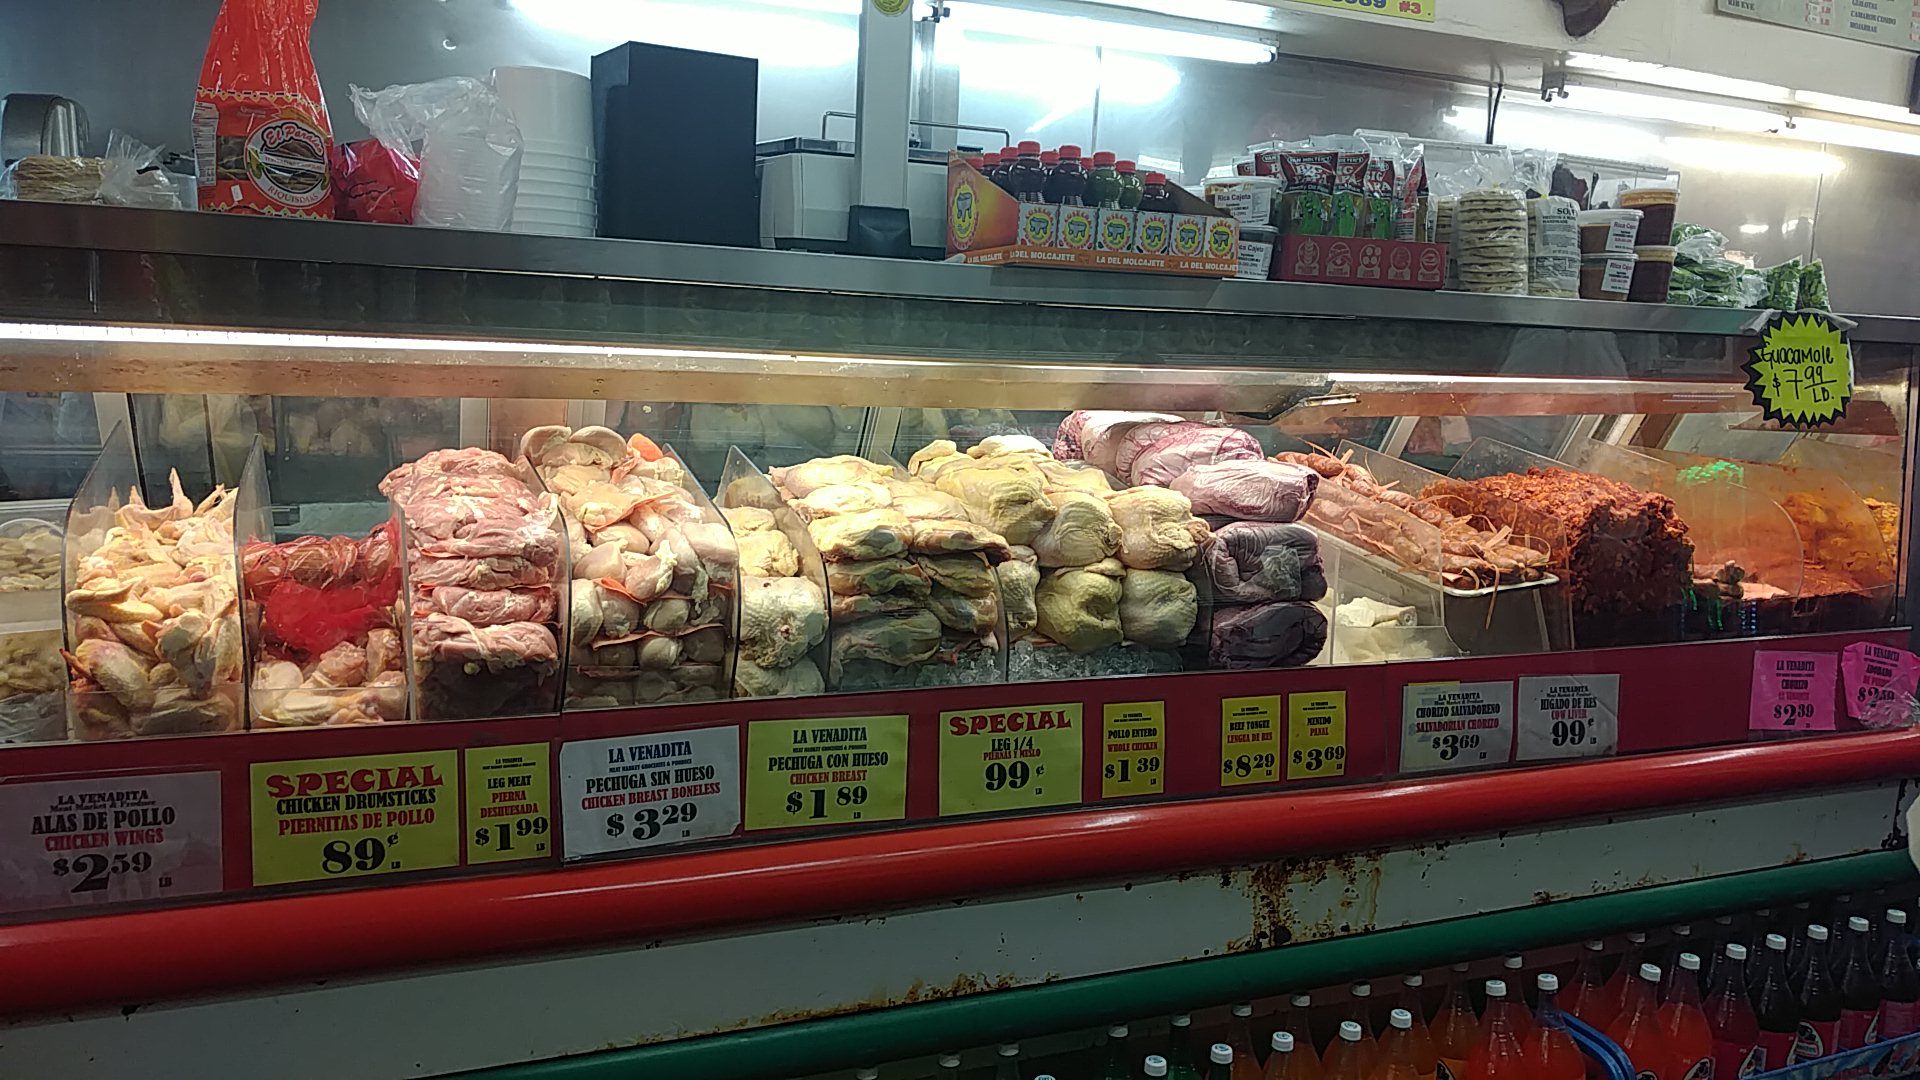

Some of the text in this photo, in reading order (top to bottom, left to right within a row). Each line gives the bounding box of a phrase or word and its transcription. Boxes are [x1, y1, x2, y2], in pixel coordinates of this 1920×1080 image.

[1030, 251, 1075, 262] MOLCAJETE
[1096, 255, 1165, 268] LA DEL MOLCAJETE
[1180, 260, 1189, 269] LA
[1191, 261, 1203, 270] DEL
[1438, 692, 1480, 701] LA VENADITA
[1559, 685, 1589, 693] VENADITA
[1416, 703, 1501, 719] CHORIZO SALVADORENO
[1540, 697, 1597, 710] HIGADO DE RES
[949, 709, 1072, 736] SPECIAL
[1230, 721, 1246, 732] BEEF
[1467, 718, 1500, 730] CHORIZO
[793, 727, 867, 744] LA VENADITA
[1108, 727, 1157, 740] POLLO ENTERO
[991, 735, 1033, 752] LEG 1/4
[1107, 741, 1158, 753] WHOLE CHICKEN
[608, 740, 692, 764] LA VENADITA
[983, 749, 1012, 762] PIERNAS
[1013, 749, 1019, 759] Y
[768, 751, 888, 772] PECHUGA CON HUESO
[266, 764, 444, 799] SPECIAL
[487, 774, 531, 790] LEG MEAT
[586, 765, 715, 794] PECHUGA SIN HUESO
[790, 769, 868, 785] CHICKEN BREAST
[58, 789, 149, 806] LA VENADITA
[276, 788, 437, 815] CHICKEN DRUMSTICKS
[492, 790, 527, 804] PIERNA
[581, 782, 720, 810] CHICKEN BREAST BONELESS
[480, 803, 539, 819] DESHUESADA
[31, 806, 176, 835] ALAS DE POLLO
[278, 807, 435, 836] PIERNITAS DE POLLO
[44, 827, 164, 852] CHICKEN WINGS
[682, 830, 690, 838] LB
[536, 843, 545, 852] LB
[158, 876, 173, 888] LB
